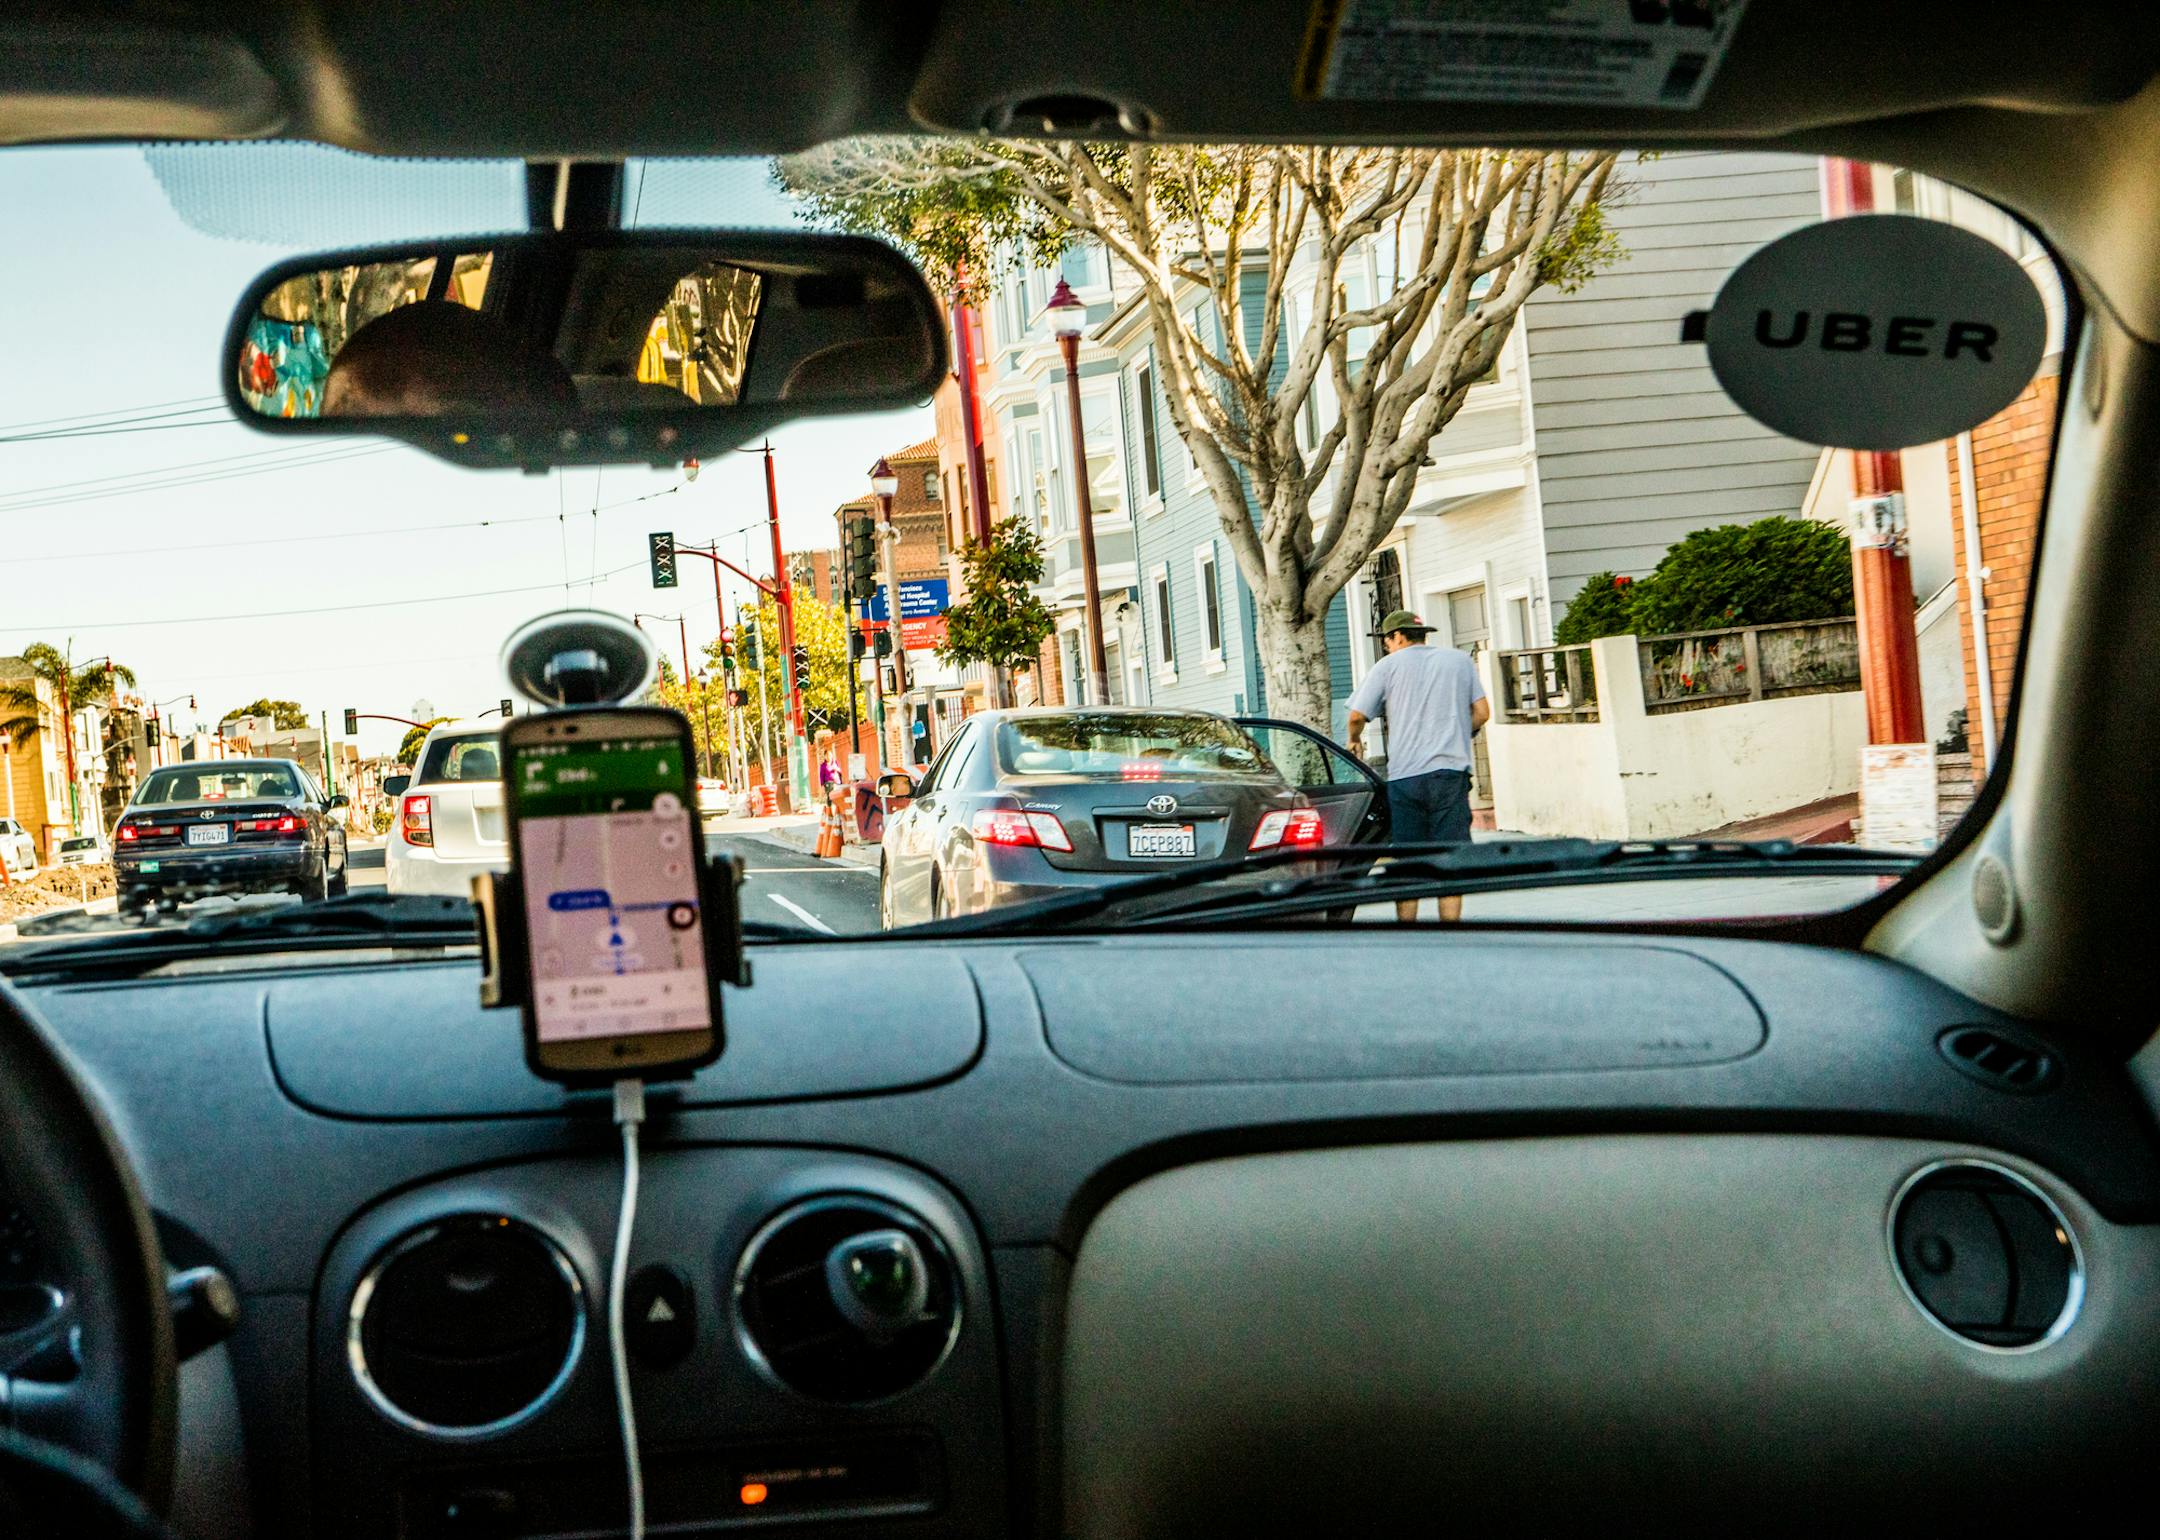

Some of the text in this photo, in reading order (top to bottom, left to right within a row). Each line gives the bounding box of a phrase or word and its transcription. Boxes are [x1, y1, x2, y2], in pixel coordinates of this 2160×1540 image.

[1754, 309, 1999, 363] UBER
[192, 831, 225, 842] 7YIG471
[1133, 835, 1191, 852] 7CEP887
